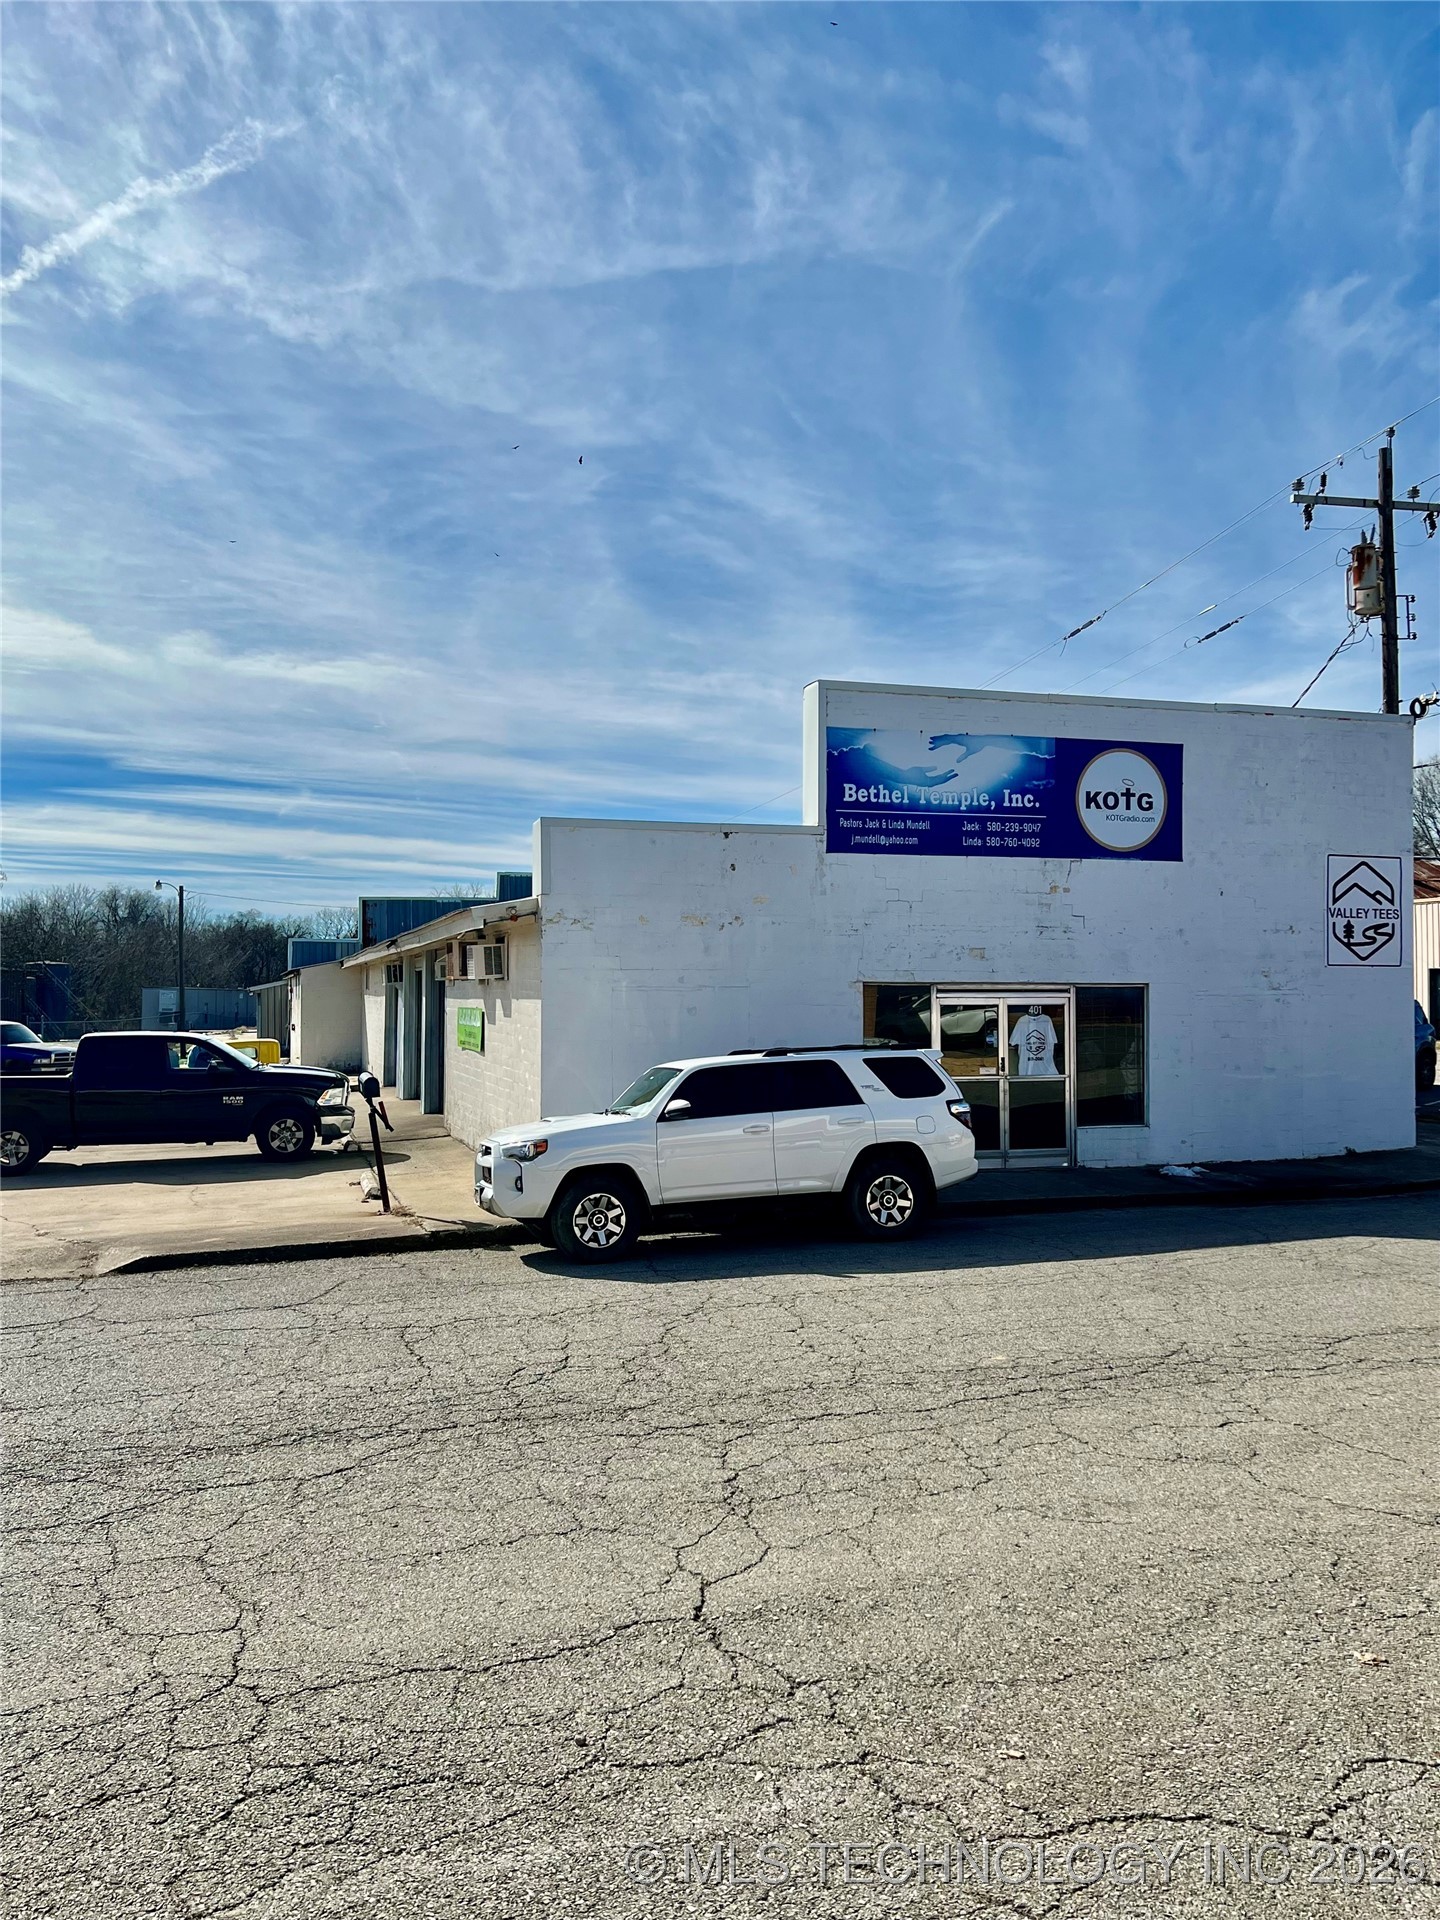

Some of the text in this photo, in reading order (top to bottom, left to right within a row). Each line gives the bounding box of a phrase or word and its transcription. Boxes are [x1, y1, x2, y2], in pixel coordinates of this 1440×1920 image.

[843, 783, 1040, 810] Bethel Temple, Inc.
[840, 817, 931, 830] Pastors Jack & Linda Mundell
[1105, 814, 1156, 823] KOTGradio.com
[962, 821, 1041, 833] Jack: 580-239-9047
[851, 834, 919, 846] j.mundell@yahoo.com
[962, 836, 1040, 848] Linda: 580-760-4092
[1328, 907, 1400, 920] VALLEY TEES
[1028, 1005, 1042, 1014] 401
